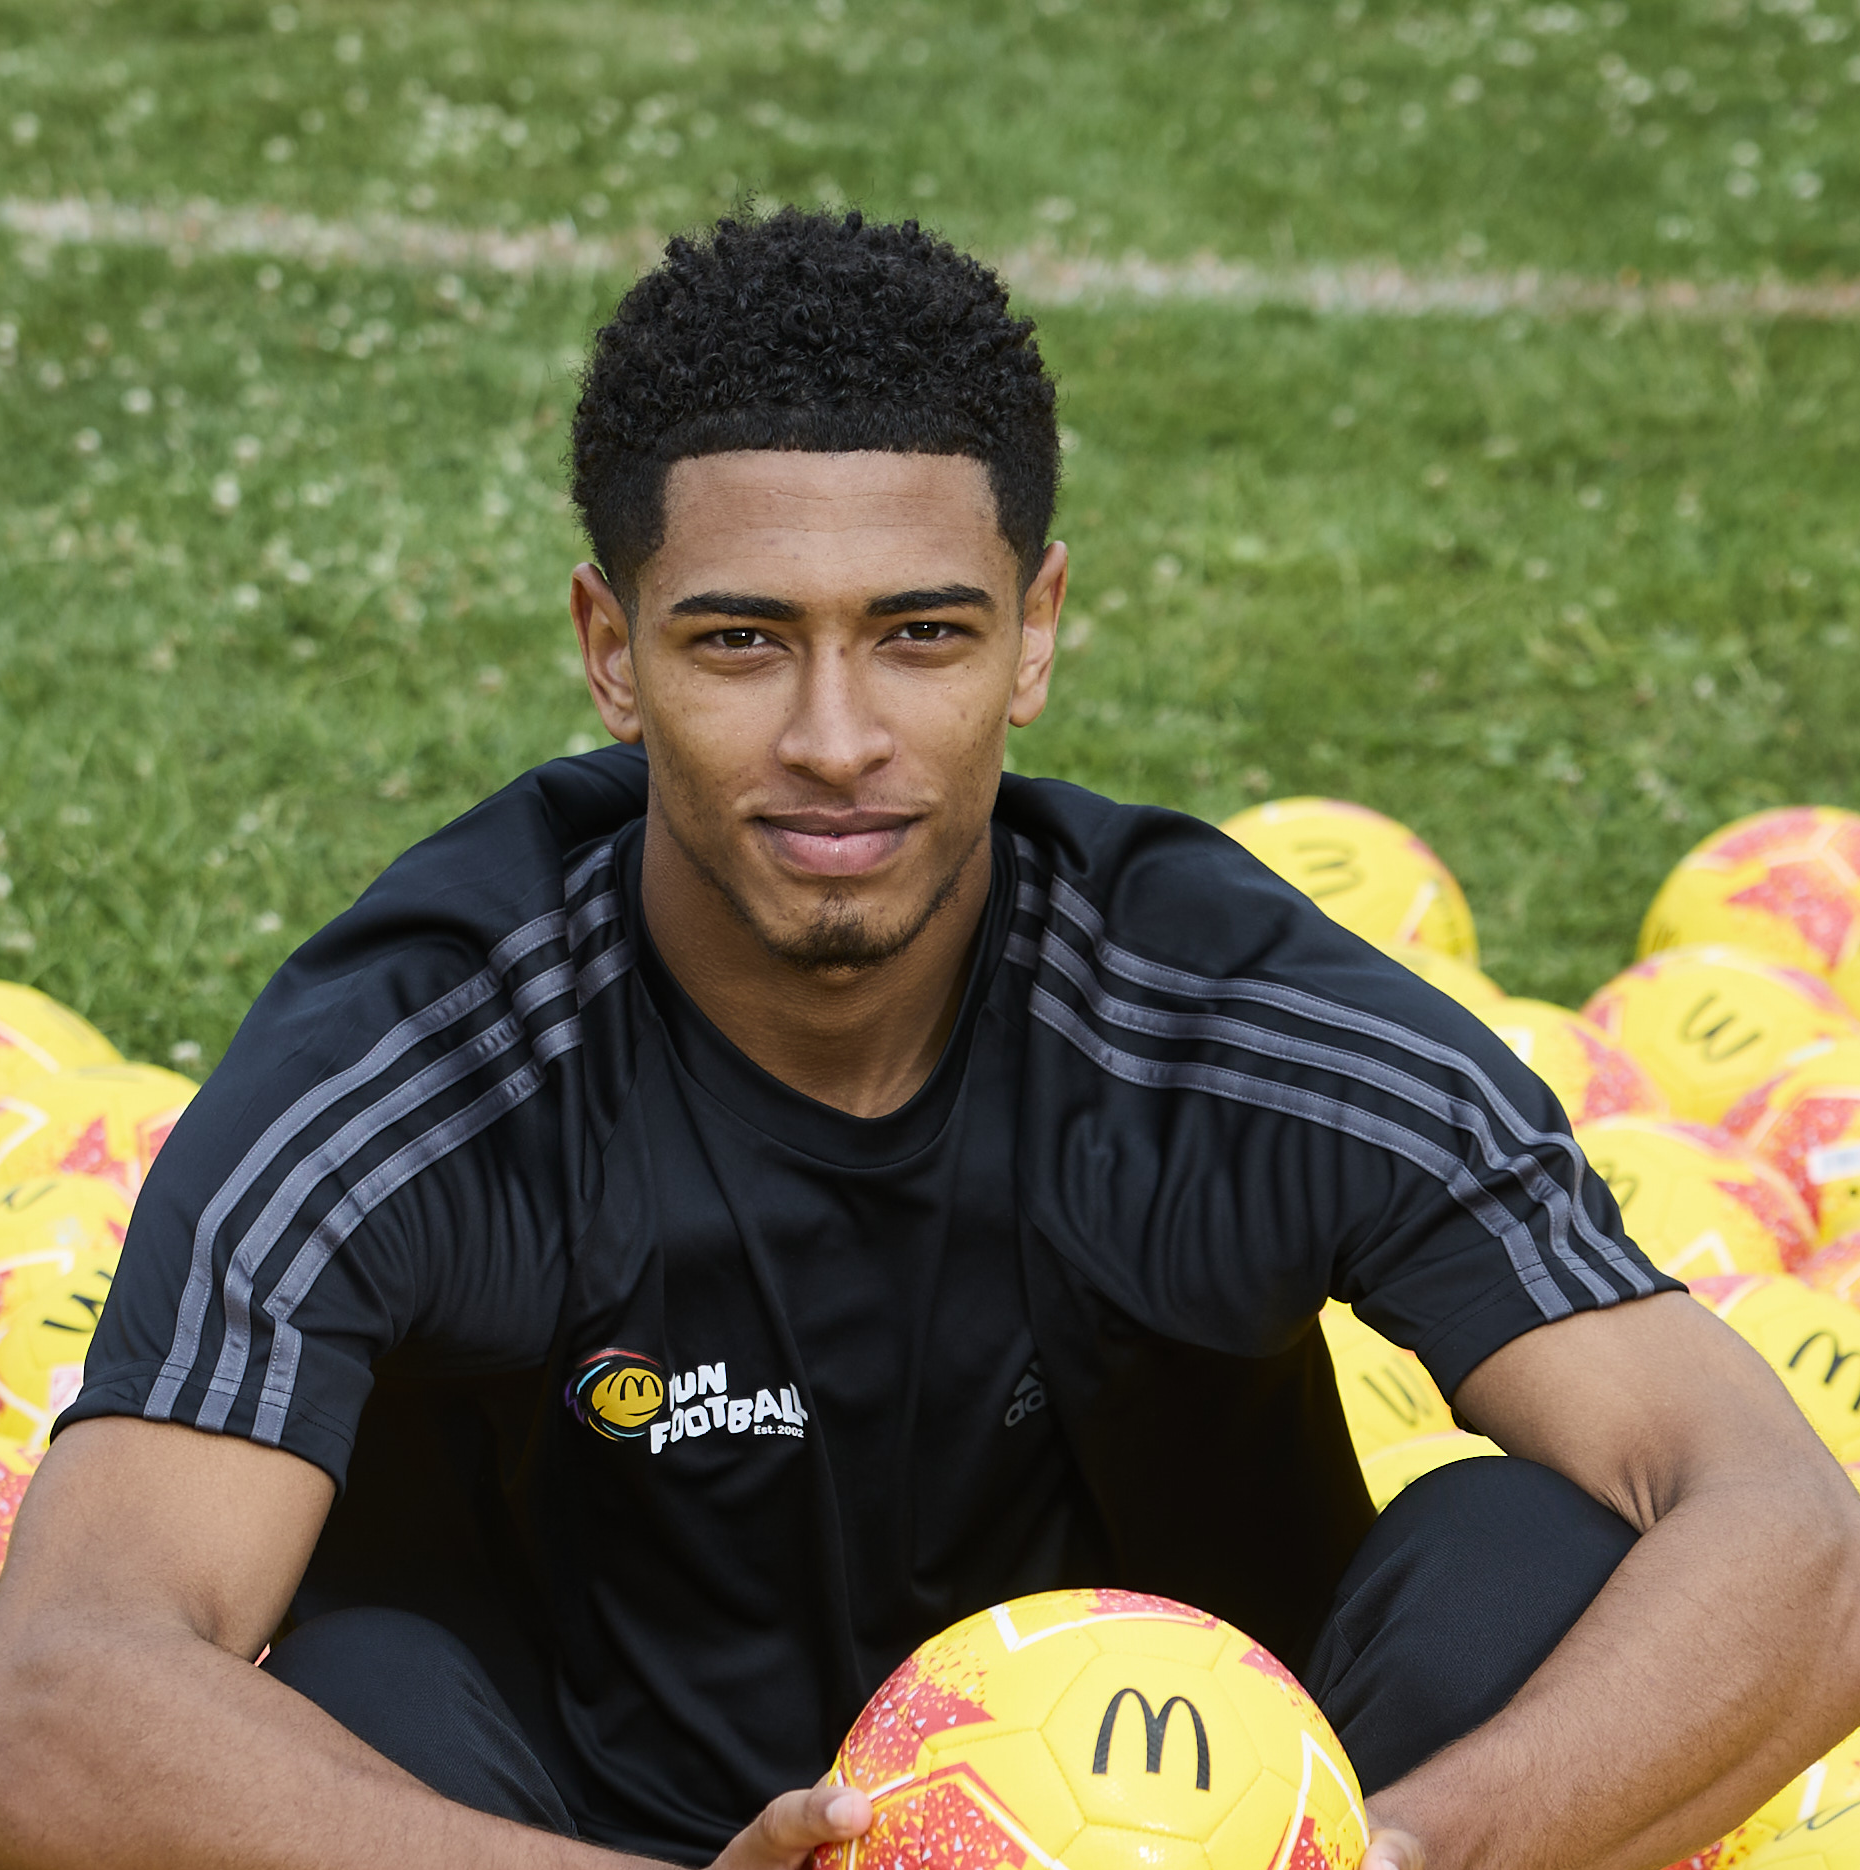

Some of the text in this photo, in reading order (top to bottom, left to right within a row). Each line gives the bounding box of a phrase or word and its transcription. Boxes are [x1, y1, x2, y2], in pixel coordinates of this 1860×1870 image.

[1294, 839, 1364, 895] M
[1679, 995, 1761, 1063] M
[650, 1383, 809, 1454] FOOTBALL
[754, 1424, 805, 1438] Est. 2002
[1093, 1688, 1210, 1790] M
